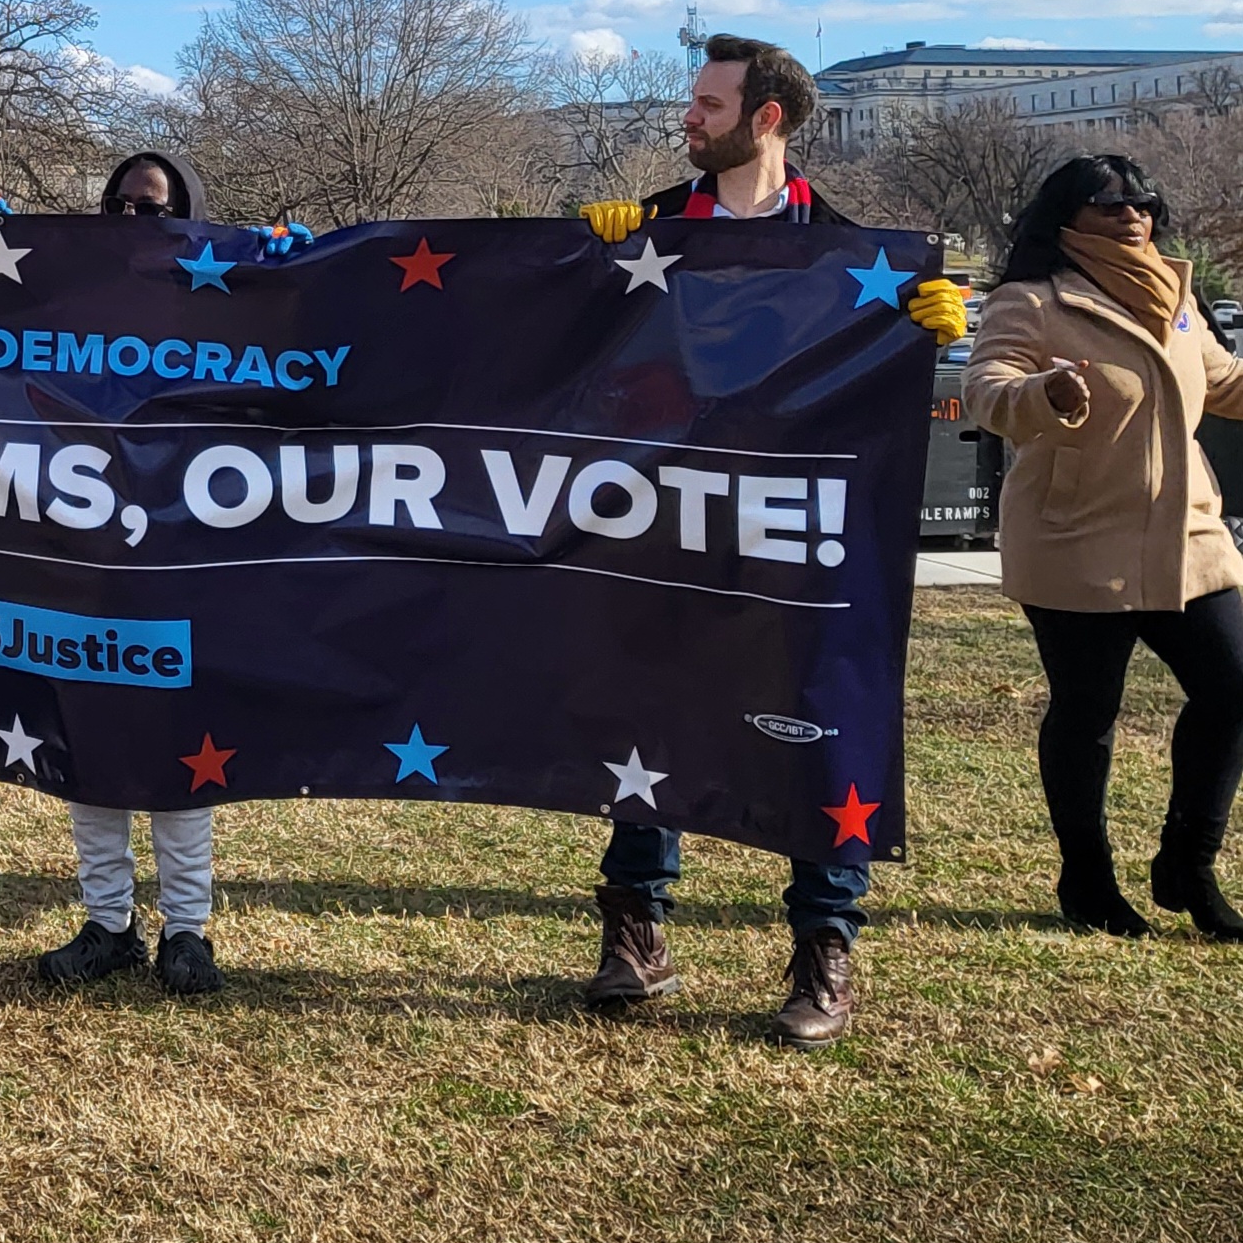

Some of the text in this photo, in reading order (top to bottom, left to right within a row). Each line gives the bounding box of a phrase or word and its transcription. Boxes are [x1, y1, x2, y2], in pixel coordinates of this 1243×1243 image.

[183, 444, 446, 530] OUR
[480, 449, 848, 567] VOTE!
[968, 486, 990, 500] 002
